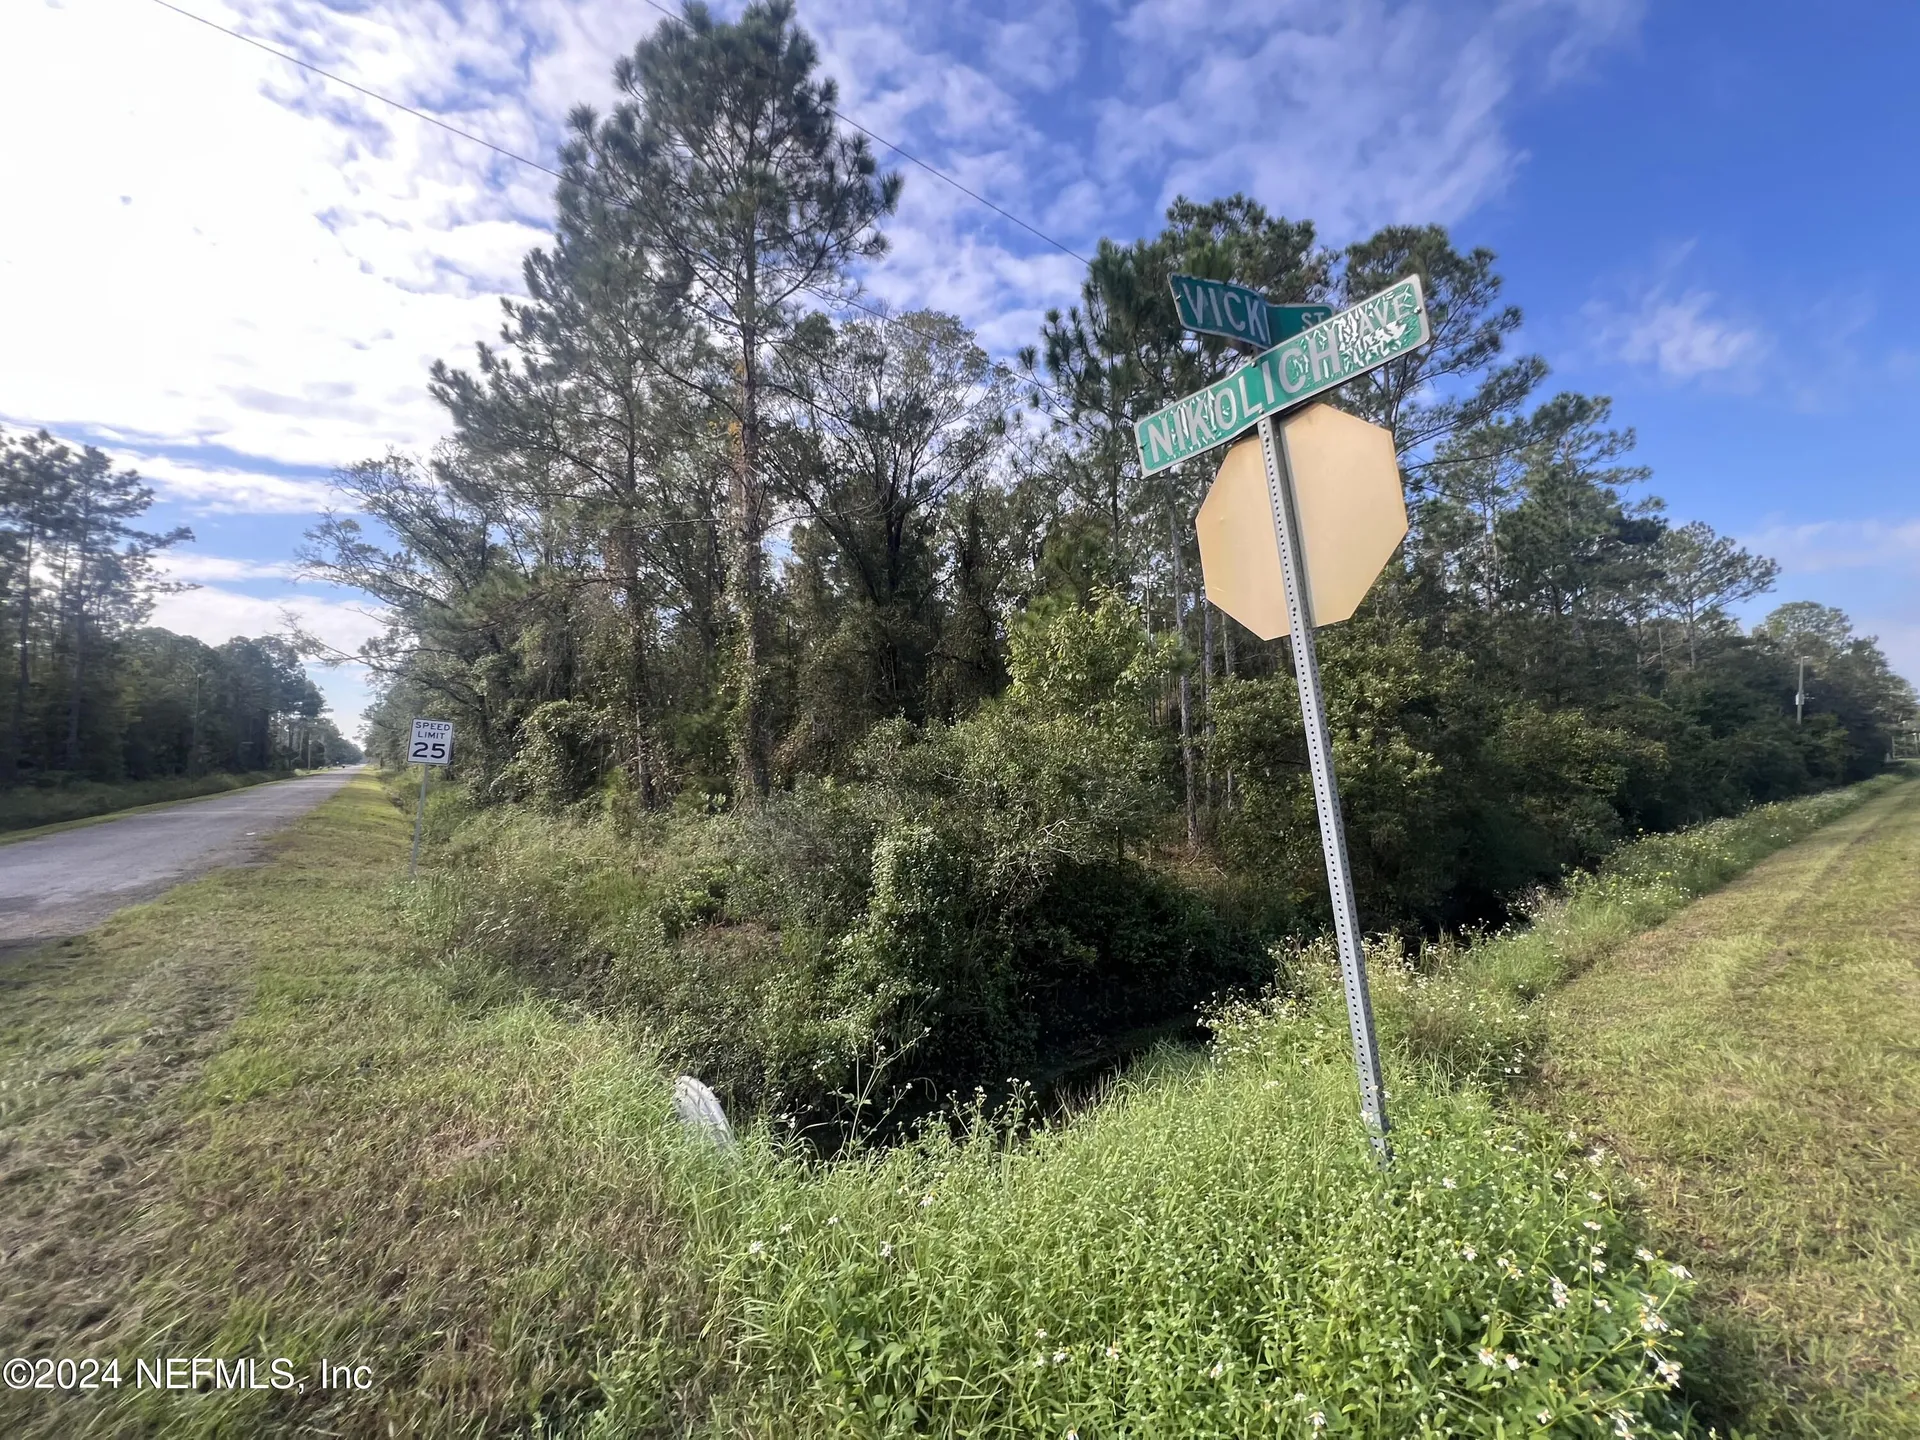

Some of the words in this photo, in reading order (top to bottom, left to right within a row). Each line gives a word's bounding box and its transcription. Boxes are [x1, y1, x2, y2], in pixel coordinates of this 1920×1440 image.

[1302, 312, 1325, 330] ST
[1147, 326, 1341, 463] NIKOLICH
[1358, 290, 1412, 339] AVE
[415, 721, 451, 731] SPEED
[417, 731, 446, 740] LIMIT
[412, 742, 446, 759] 25
